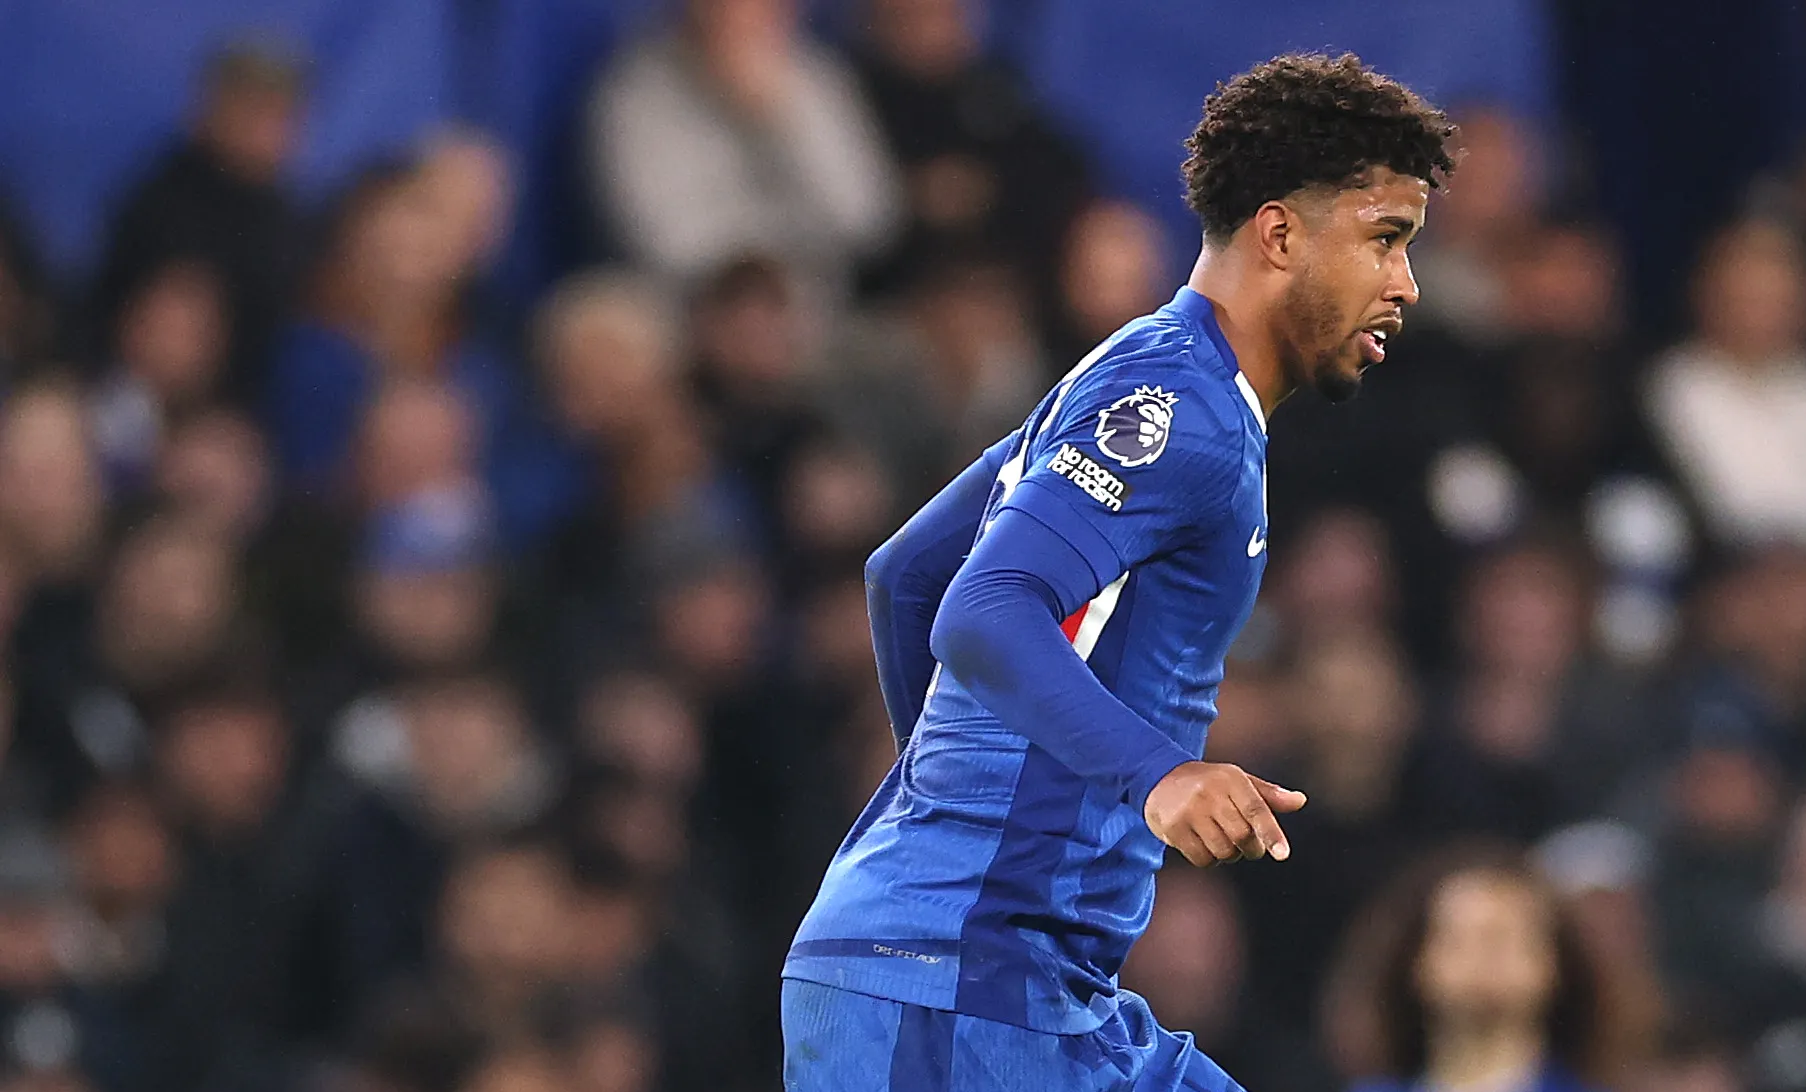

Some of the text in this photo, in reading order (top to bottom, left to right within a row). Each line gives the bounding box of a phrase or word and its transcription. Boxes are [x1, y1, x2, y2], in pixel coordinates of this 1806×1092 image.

[1046, 459, 1122, 512] for racism
[1054, 443, 1124, 497] No room
